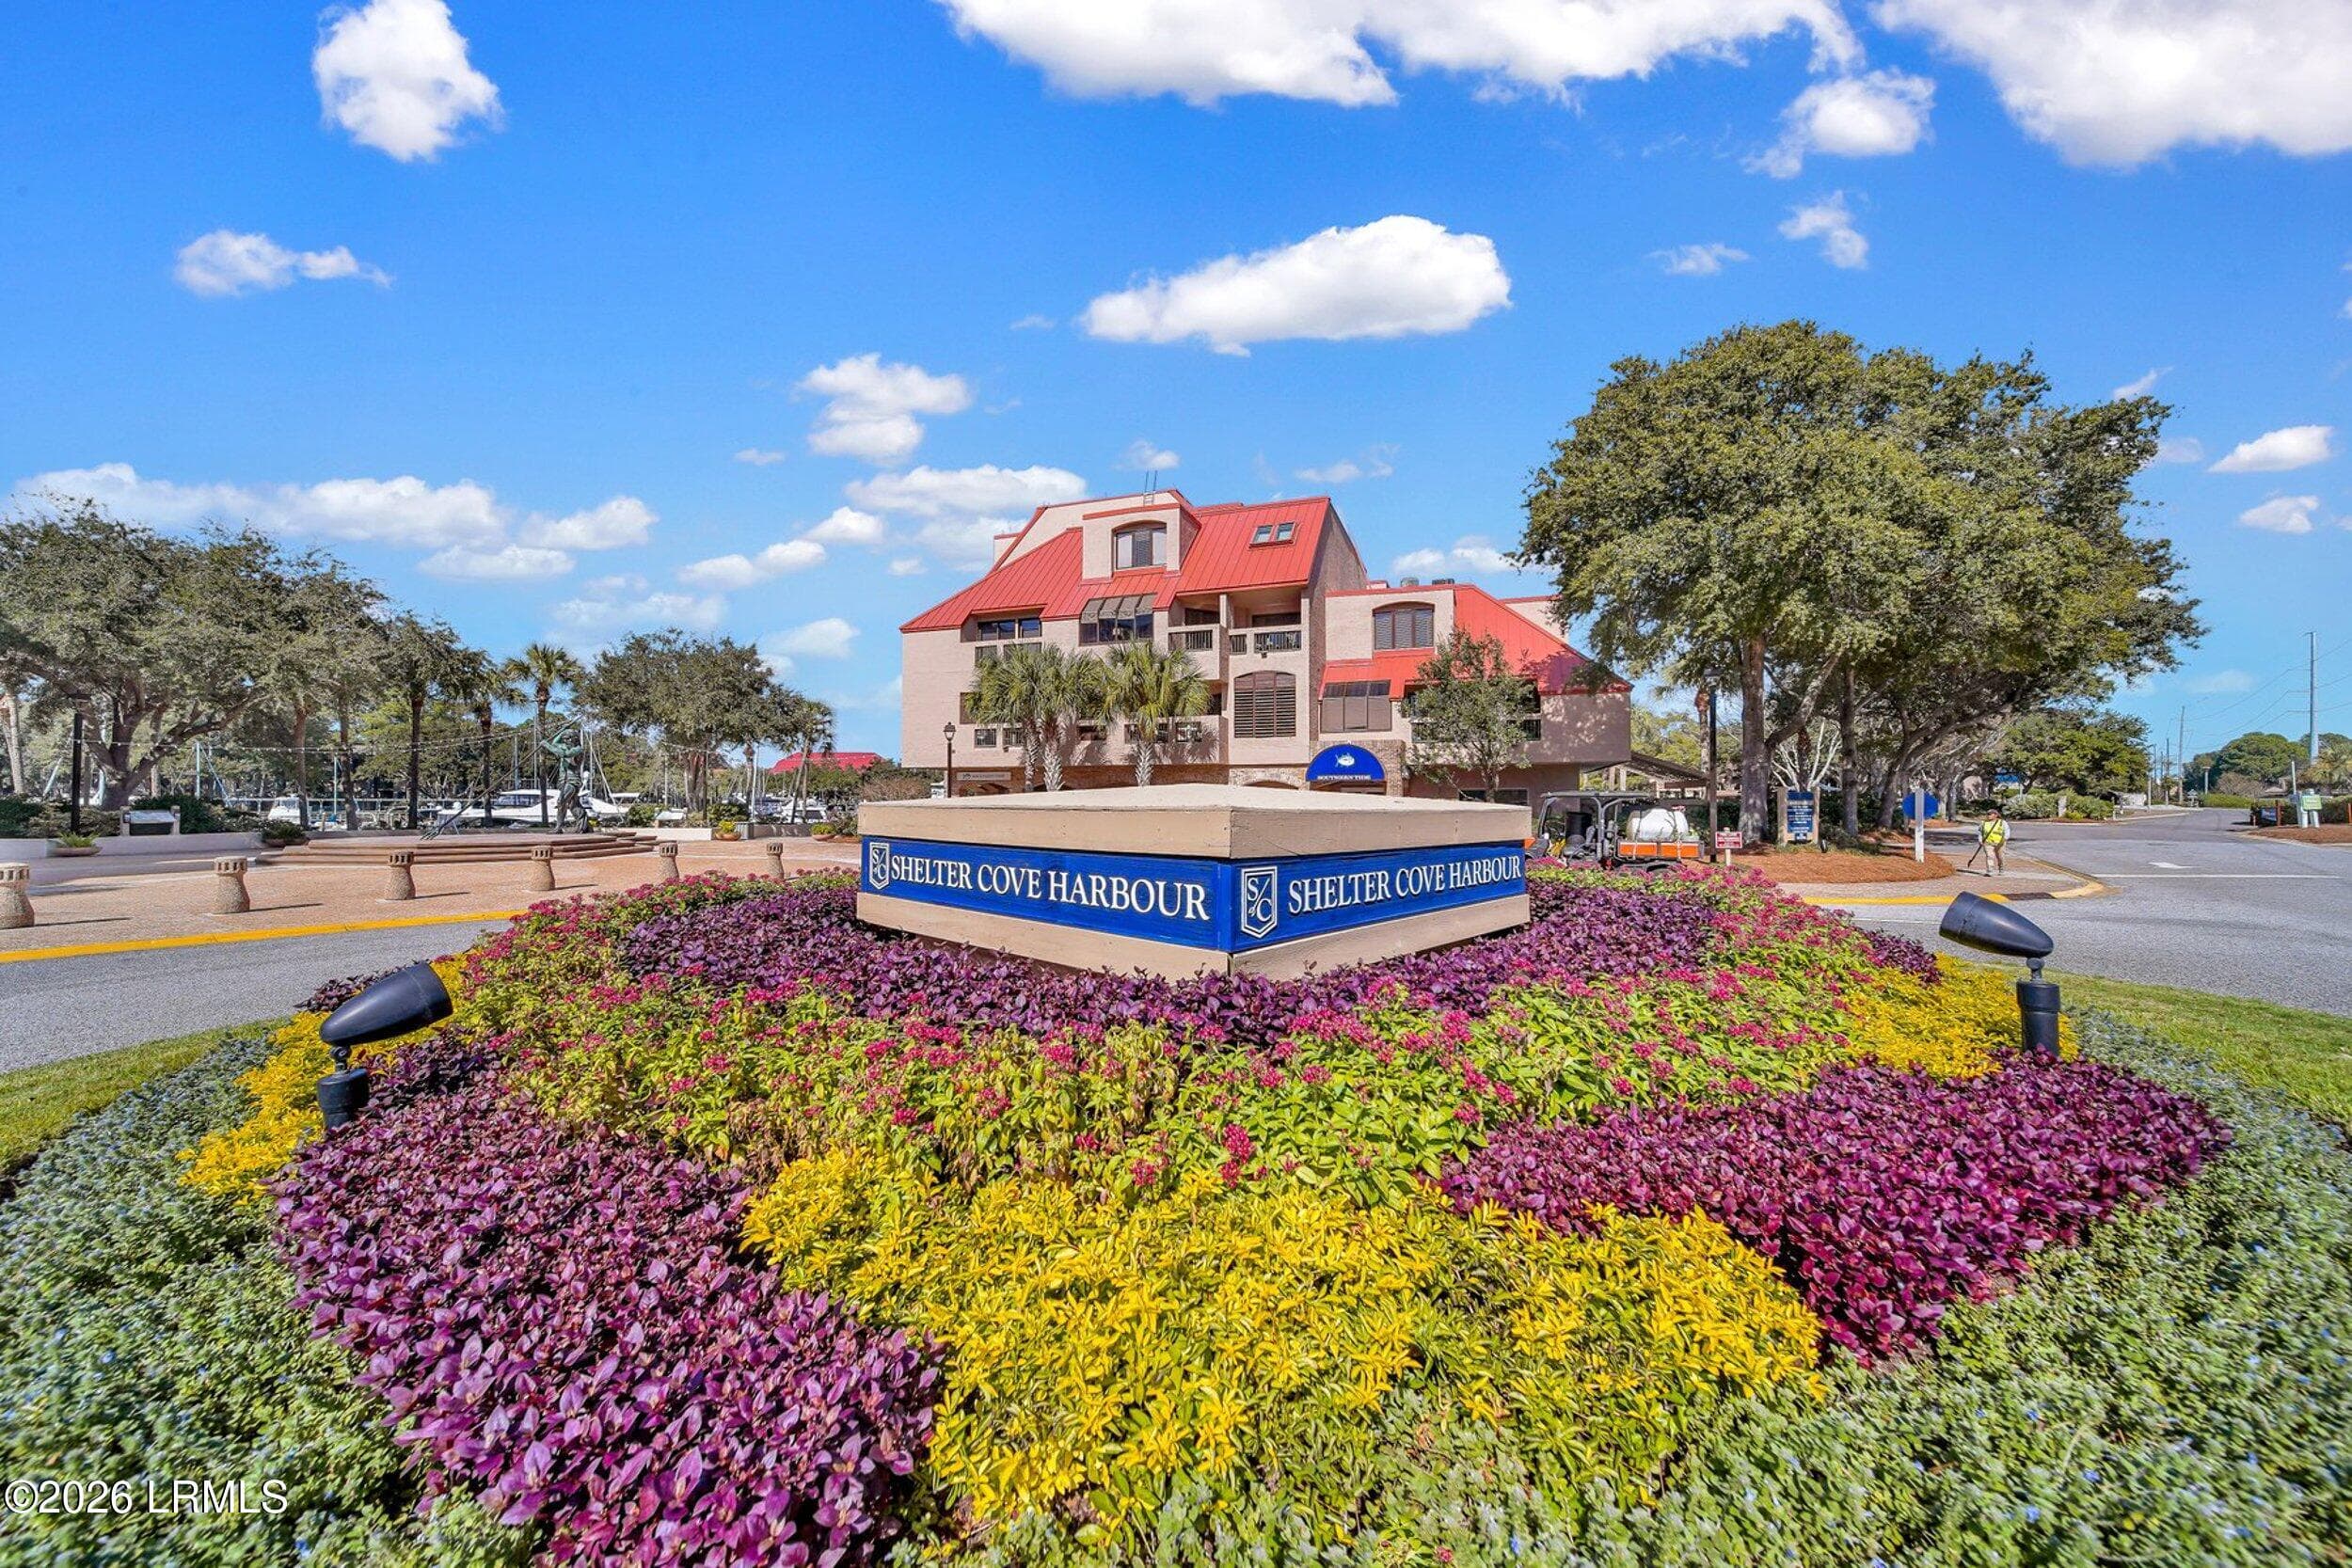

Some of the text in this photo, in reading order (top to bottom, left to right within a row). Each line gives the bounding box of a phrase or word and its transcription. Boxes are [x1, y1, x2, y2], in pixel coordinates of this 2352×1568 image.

[890, 855, 1210, 921] SHELTER COVE HARBOUR
[1288, 855, 1521, 914] SHELTER COVE HARBOUR
